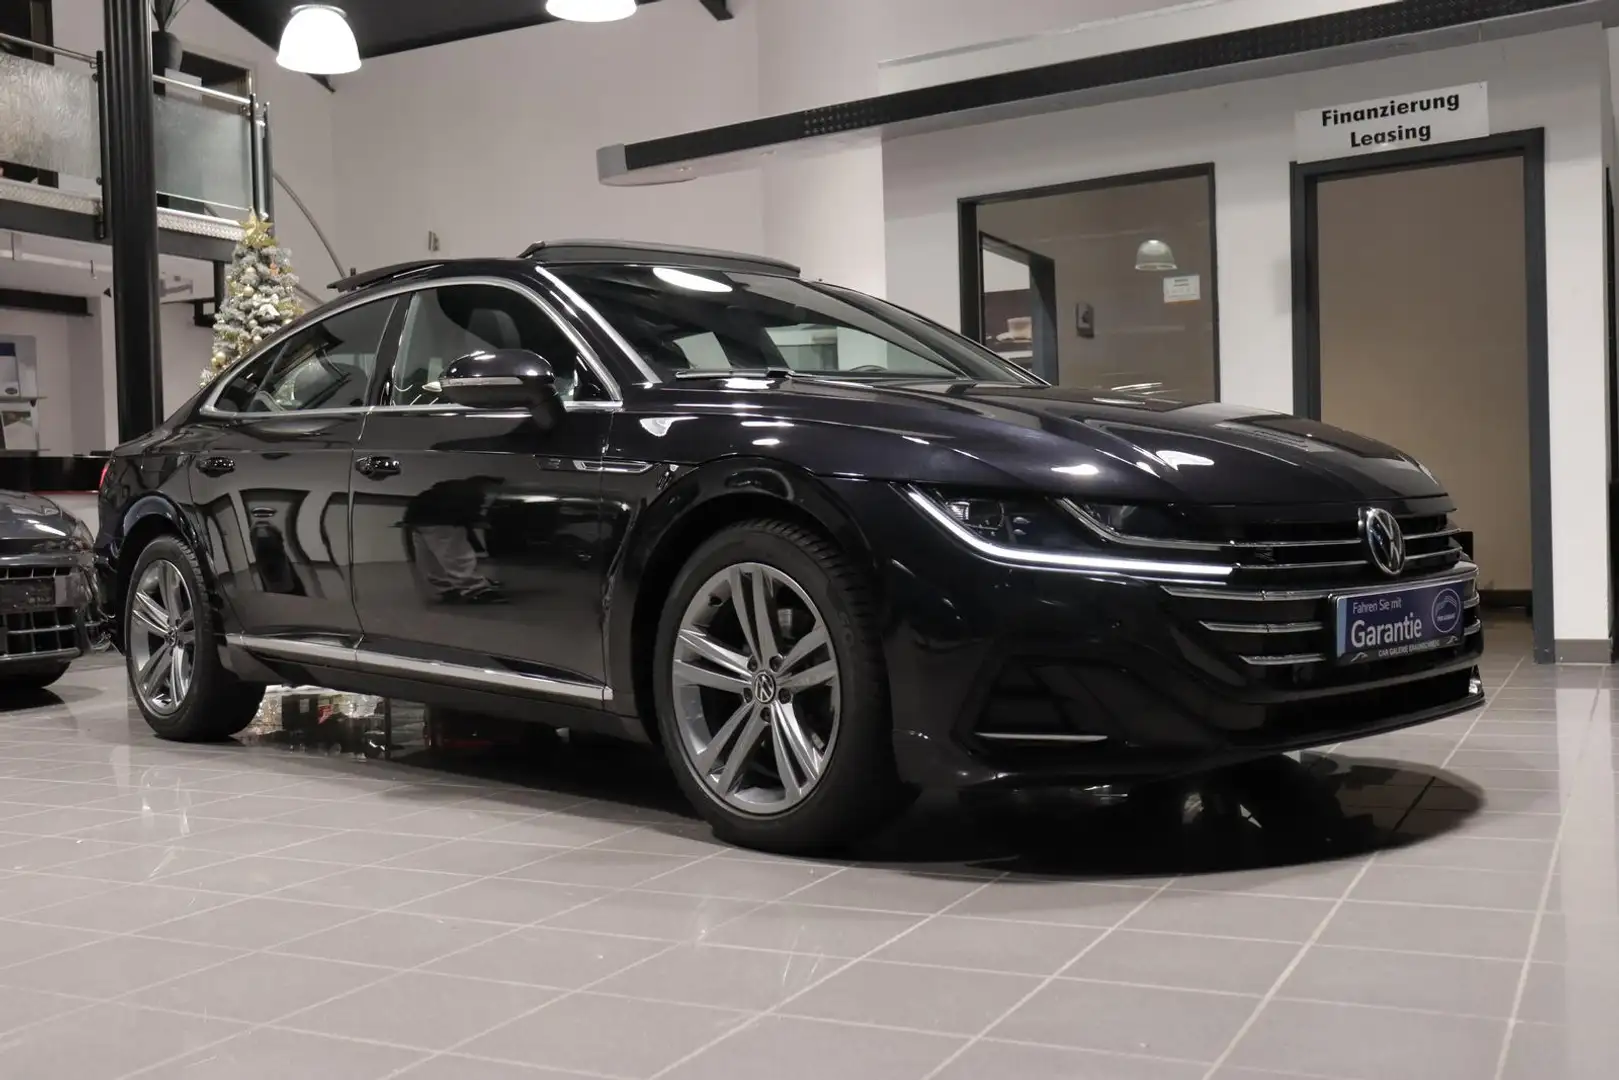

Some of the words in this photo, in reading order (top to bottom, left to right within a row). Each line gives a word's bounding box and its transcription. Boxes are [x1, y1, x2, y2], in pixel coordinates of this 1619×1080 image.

[1321, 94, 1460, 127] Finanzierung
[1350, 125, 1432, 148] Leasing
[1352, 601, 1378, 614] Fahren
[1379, 599, 1390, 611] Sie
[1391, 596, 1403, 609] mit
[1351, 612, 1423, 648] Garantie
